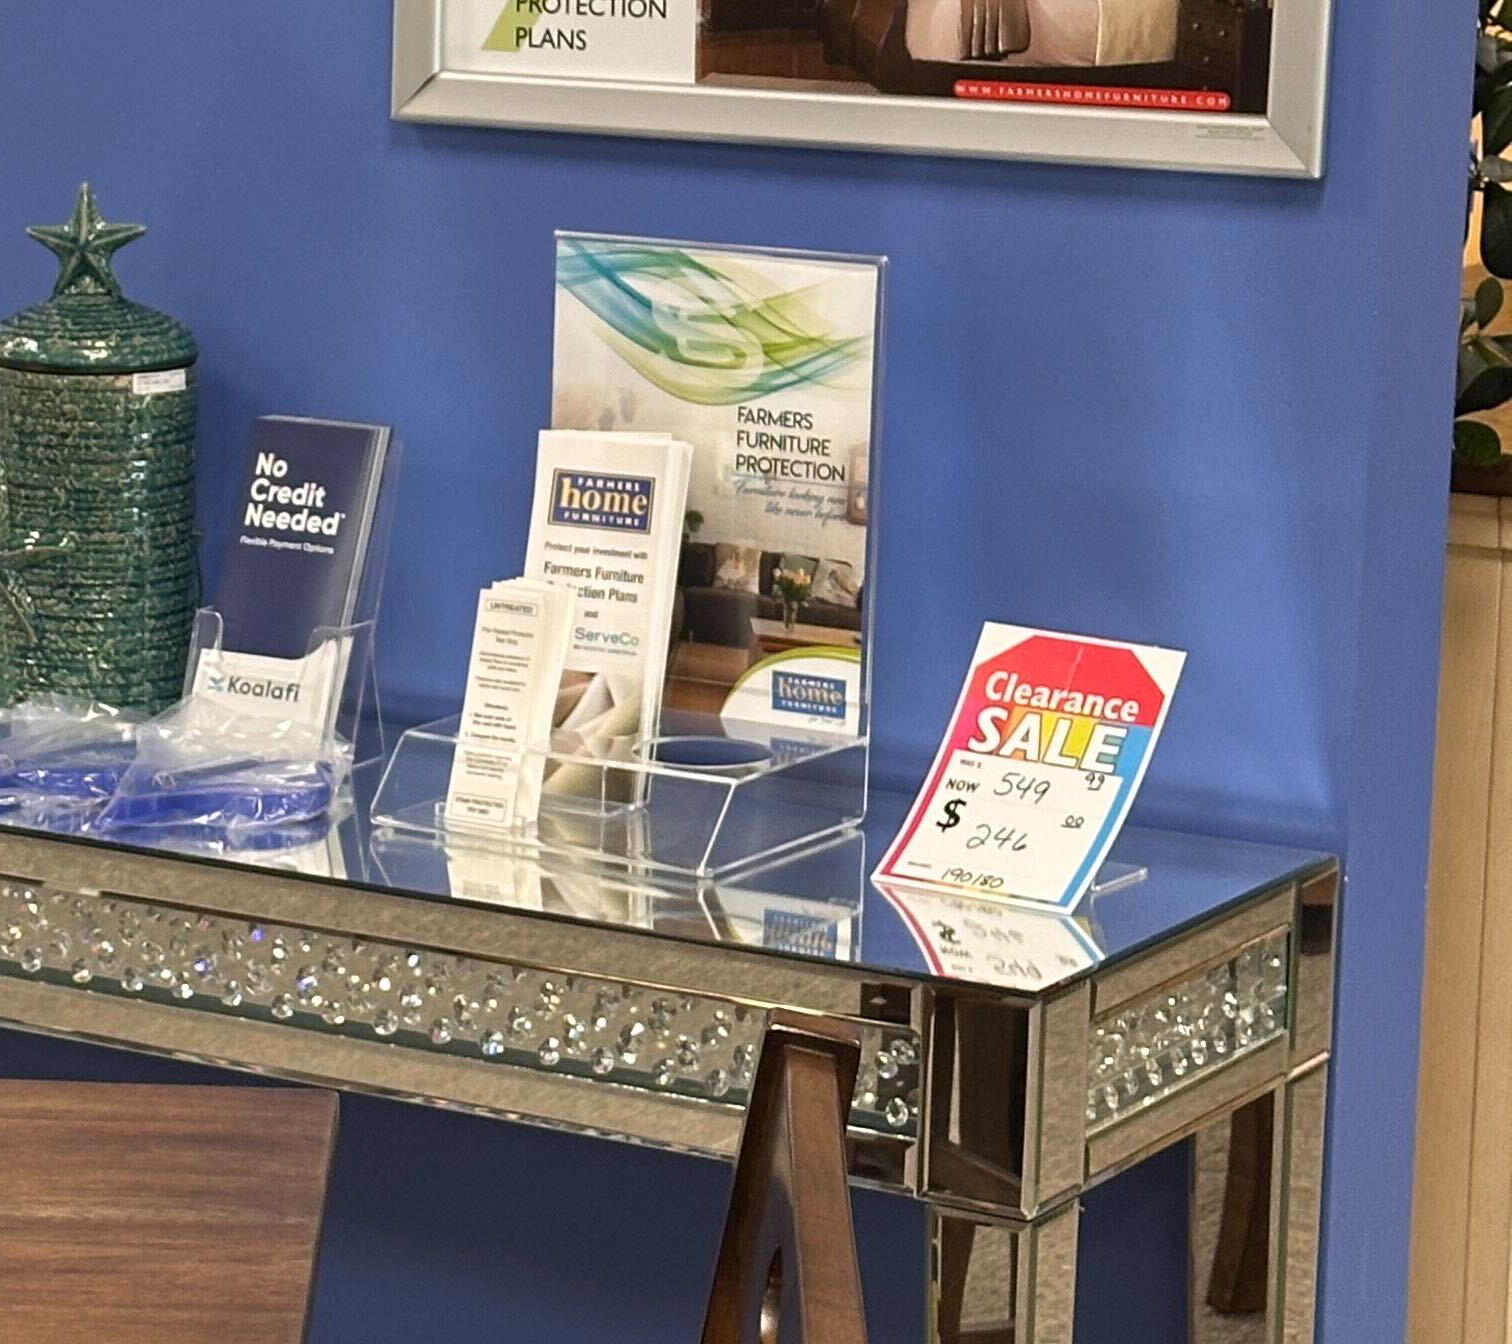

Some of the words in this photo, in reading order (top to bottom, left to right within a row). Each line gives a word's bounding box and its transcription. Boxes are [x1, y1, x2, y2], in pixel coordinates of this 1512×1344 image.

[514, 27, 587, 50] PLANS
[737, 406, 814, 430] FARMERS
[736, 430, 832, 457] FURNITURE
[255, 451, 288, 478] No
[735, 454, 846, 482] PROTECTION
[250, 477, 326, 508] Credit
[559, 475, 648, 516] home
[578, 477, 640, 493] FARMERS
[544, 560, 592, 579] Farmers
[595, 566, 645, 584] Furniture
[608, 587, 639, 604] Plans
[573, 625, 640, 647] ServeCo
[227, 674, 301, 703] Koalafi
[777, 675, 843, 706] home
[984, 670, 1140, 723] Clearance
[967, 705, 1129, 774] SALE
[945, 777, 981, 794] NOW
[993, 771, 1051, 805] 549
[936, 797, 967, 832] $
[966, 823, 1028, 853] 246
[940, 867, 1005, 890] 190180
